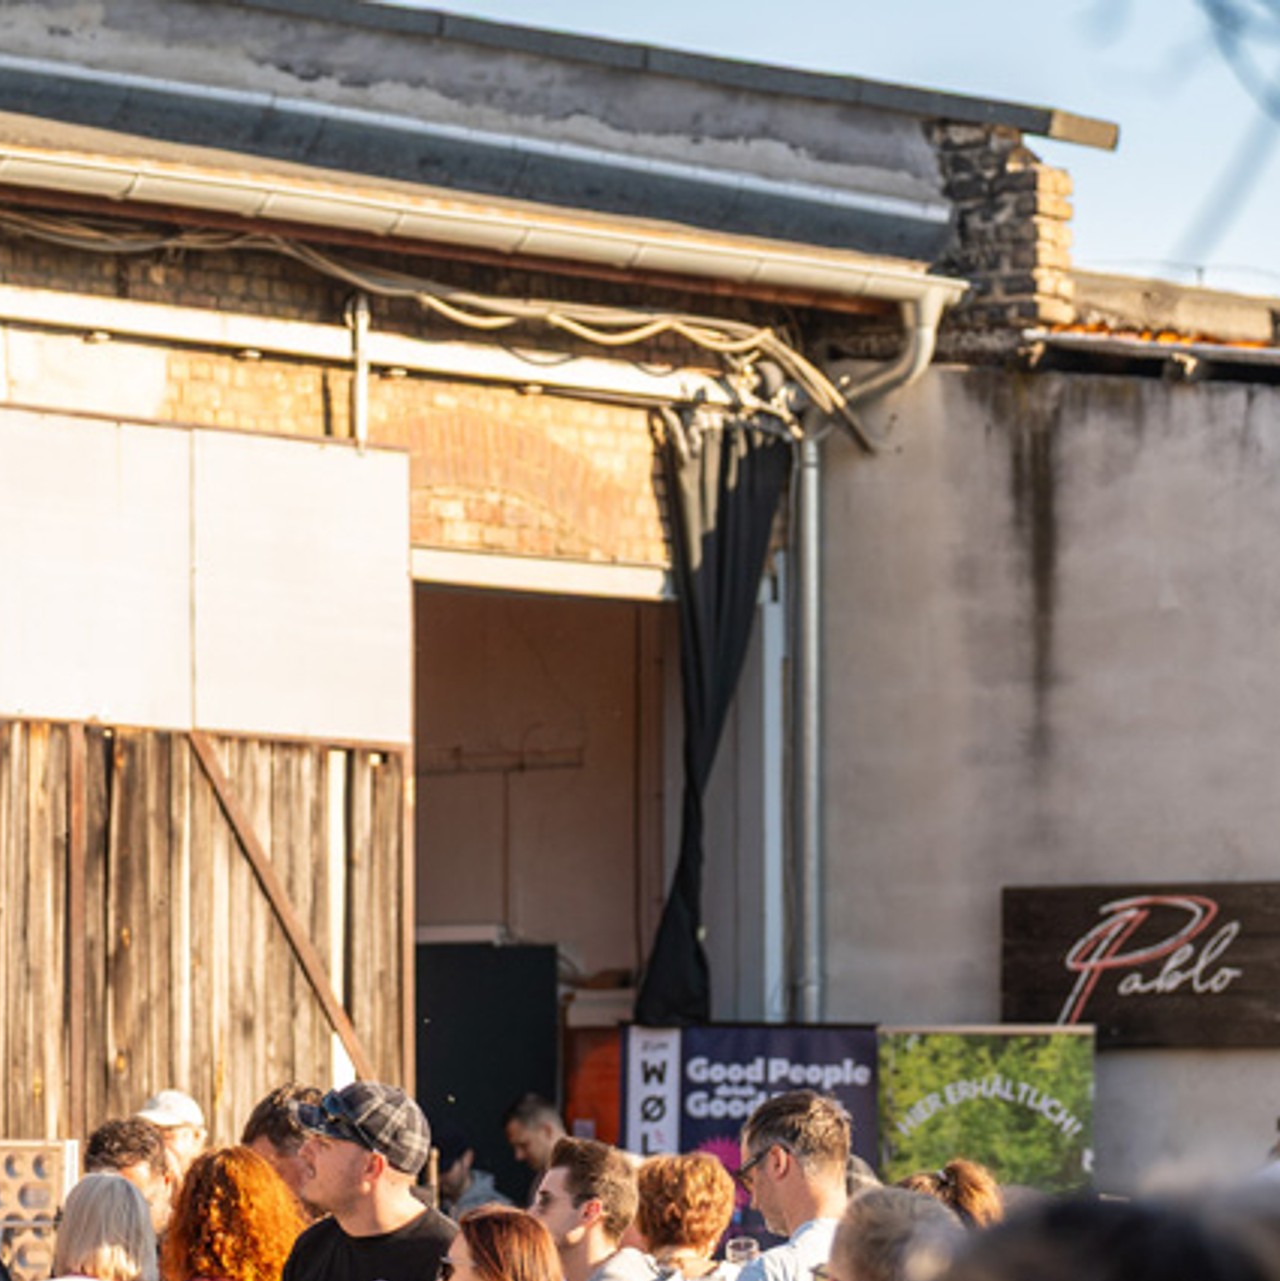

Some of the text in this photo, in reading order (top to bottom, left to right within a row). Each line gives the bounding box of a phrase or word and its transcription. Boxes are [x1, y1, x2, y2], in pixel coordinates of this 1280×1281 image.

[1055, 894, 1243, 1026] Pablo
[686, 1056, 873, 1090] Good People
[896, 1092, 945, 1137] HIER
